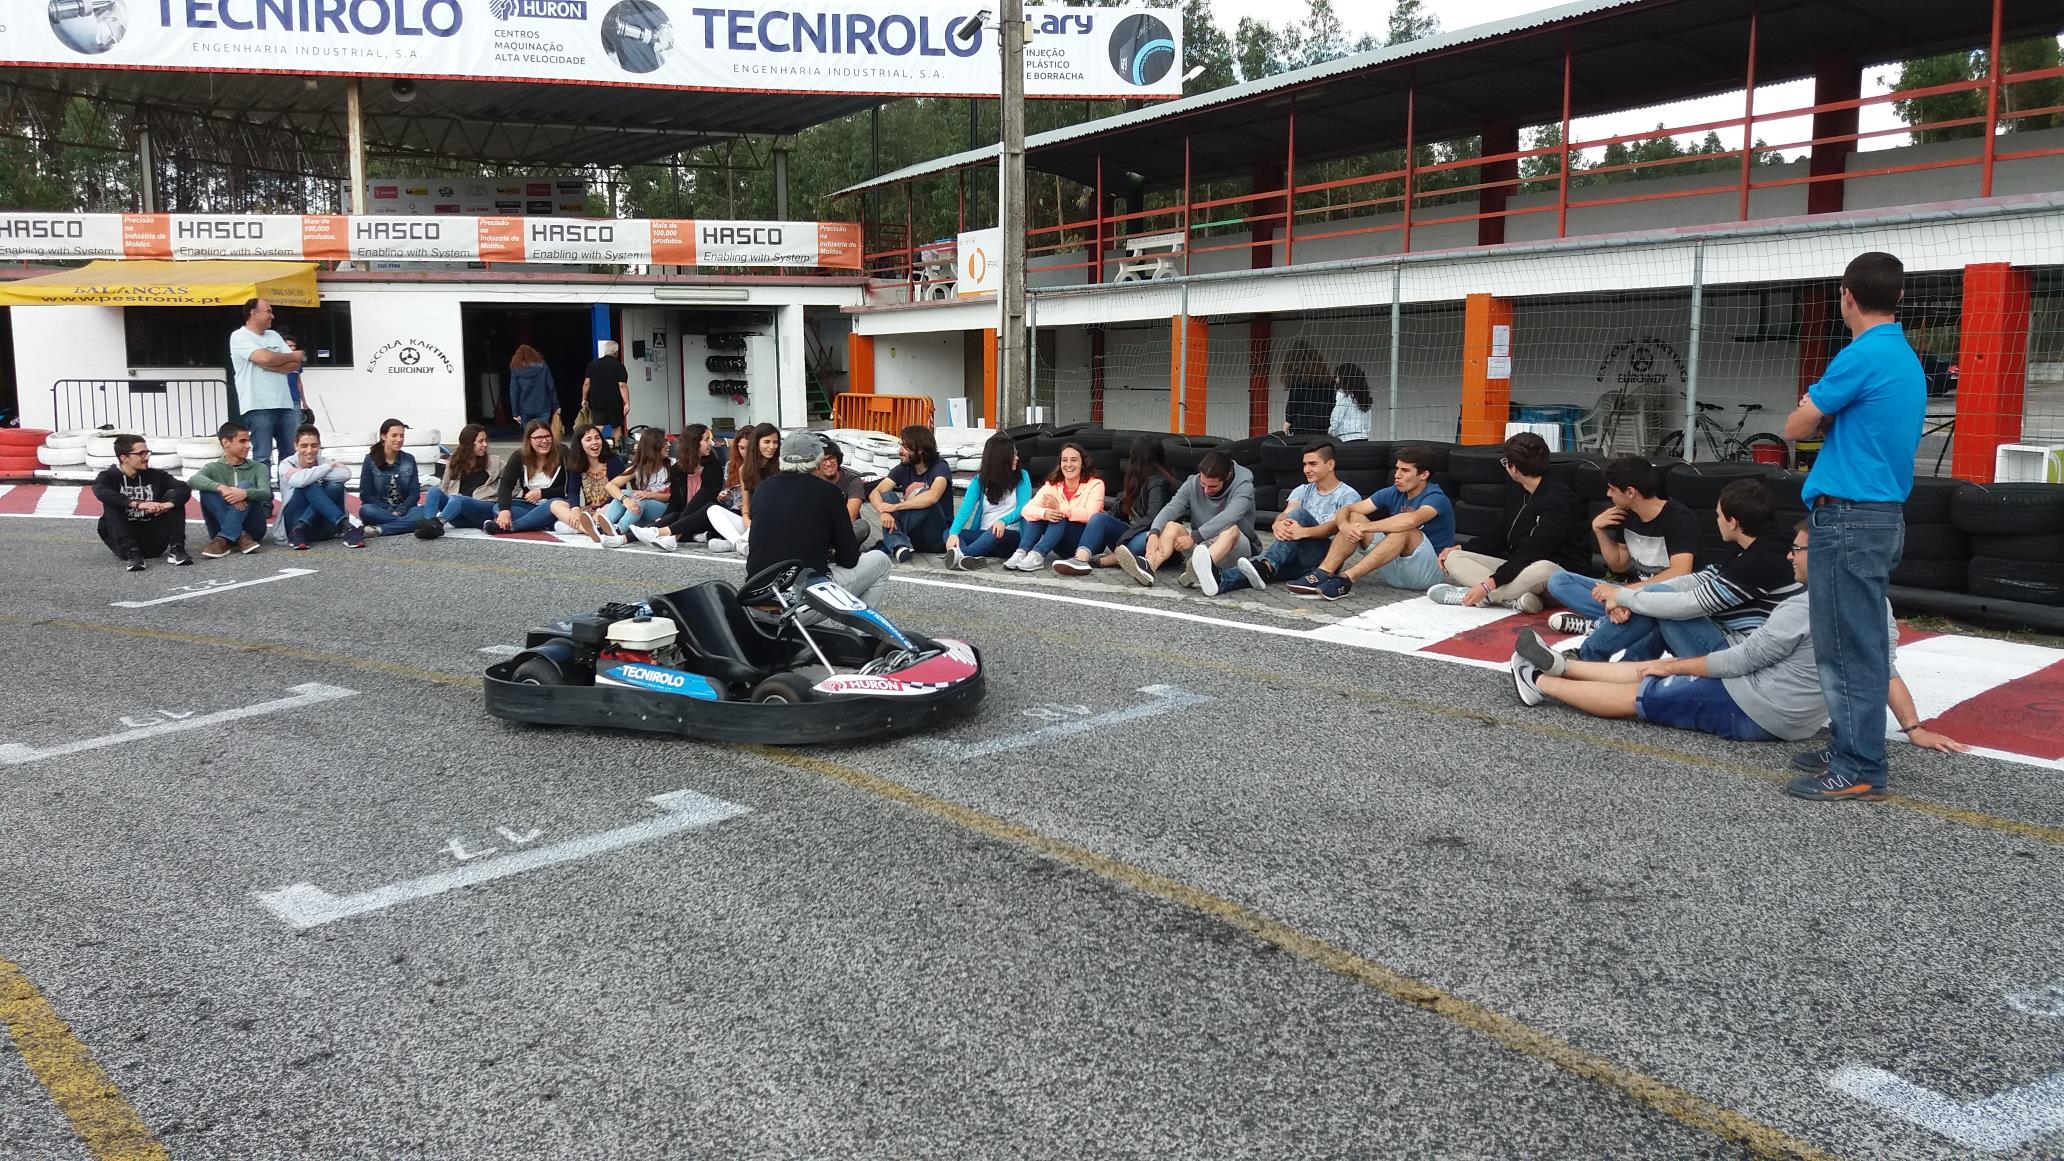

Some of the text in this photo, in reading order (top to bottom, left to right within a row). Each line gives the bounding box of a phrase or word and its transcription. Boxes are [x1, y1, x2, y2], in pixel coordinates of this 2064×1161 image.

[521, 0, 583, 18] HURON
[158, 0, 463, 38] TECNIROLO
[494, 29, 540, 39] CENTROS
[692, 8, 983, 57] TECNIROLO
[192, 42, 288, 55] ENGENHARIA
[295, 45, 390, 60] INDUSTRIAL,
[494, 40, 564, 52] MAQUINAÇÃO
[1026, 48, 1065, 58] INJEÇÃO
[494, 53, 586, 66] ALTA VELOCIDADE
[1026, 60, 1070, 69] PLÁSTICO
[733, 64, 822, 77] ENGENHARIA
[828, 66, 914, 80] INDUSTRIAL,
[1026, 72, 1084, 80] E BORRACHA
[178, 221, 263, 239] HASCO
[356, 223, 440, 240] HASCO
[532, 224, 614, 243] HASCO
[703, 227, 783, 245] HASCO
[48, 246, 70, 255] with
[179, 246, 297, 257] Enabling with System.
[357, 248, 473, 259] Enabling with System.
[532, 249, 645, 261] Enabling with System.
[703, 251, 813, 263] Enabling with System.
[41, 295, 222, 305] www.pestronix.pt
[366, 338, 455, 374] ESCOLA KARTING
[388, 366, 435, 374] EUROINDY
[622, 665, 685, 688] TECNIROLO
[850, 679, 900, 690] HURON
